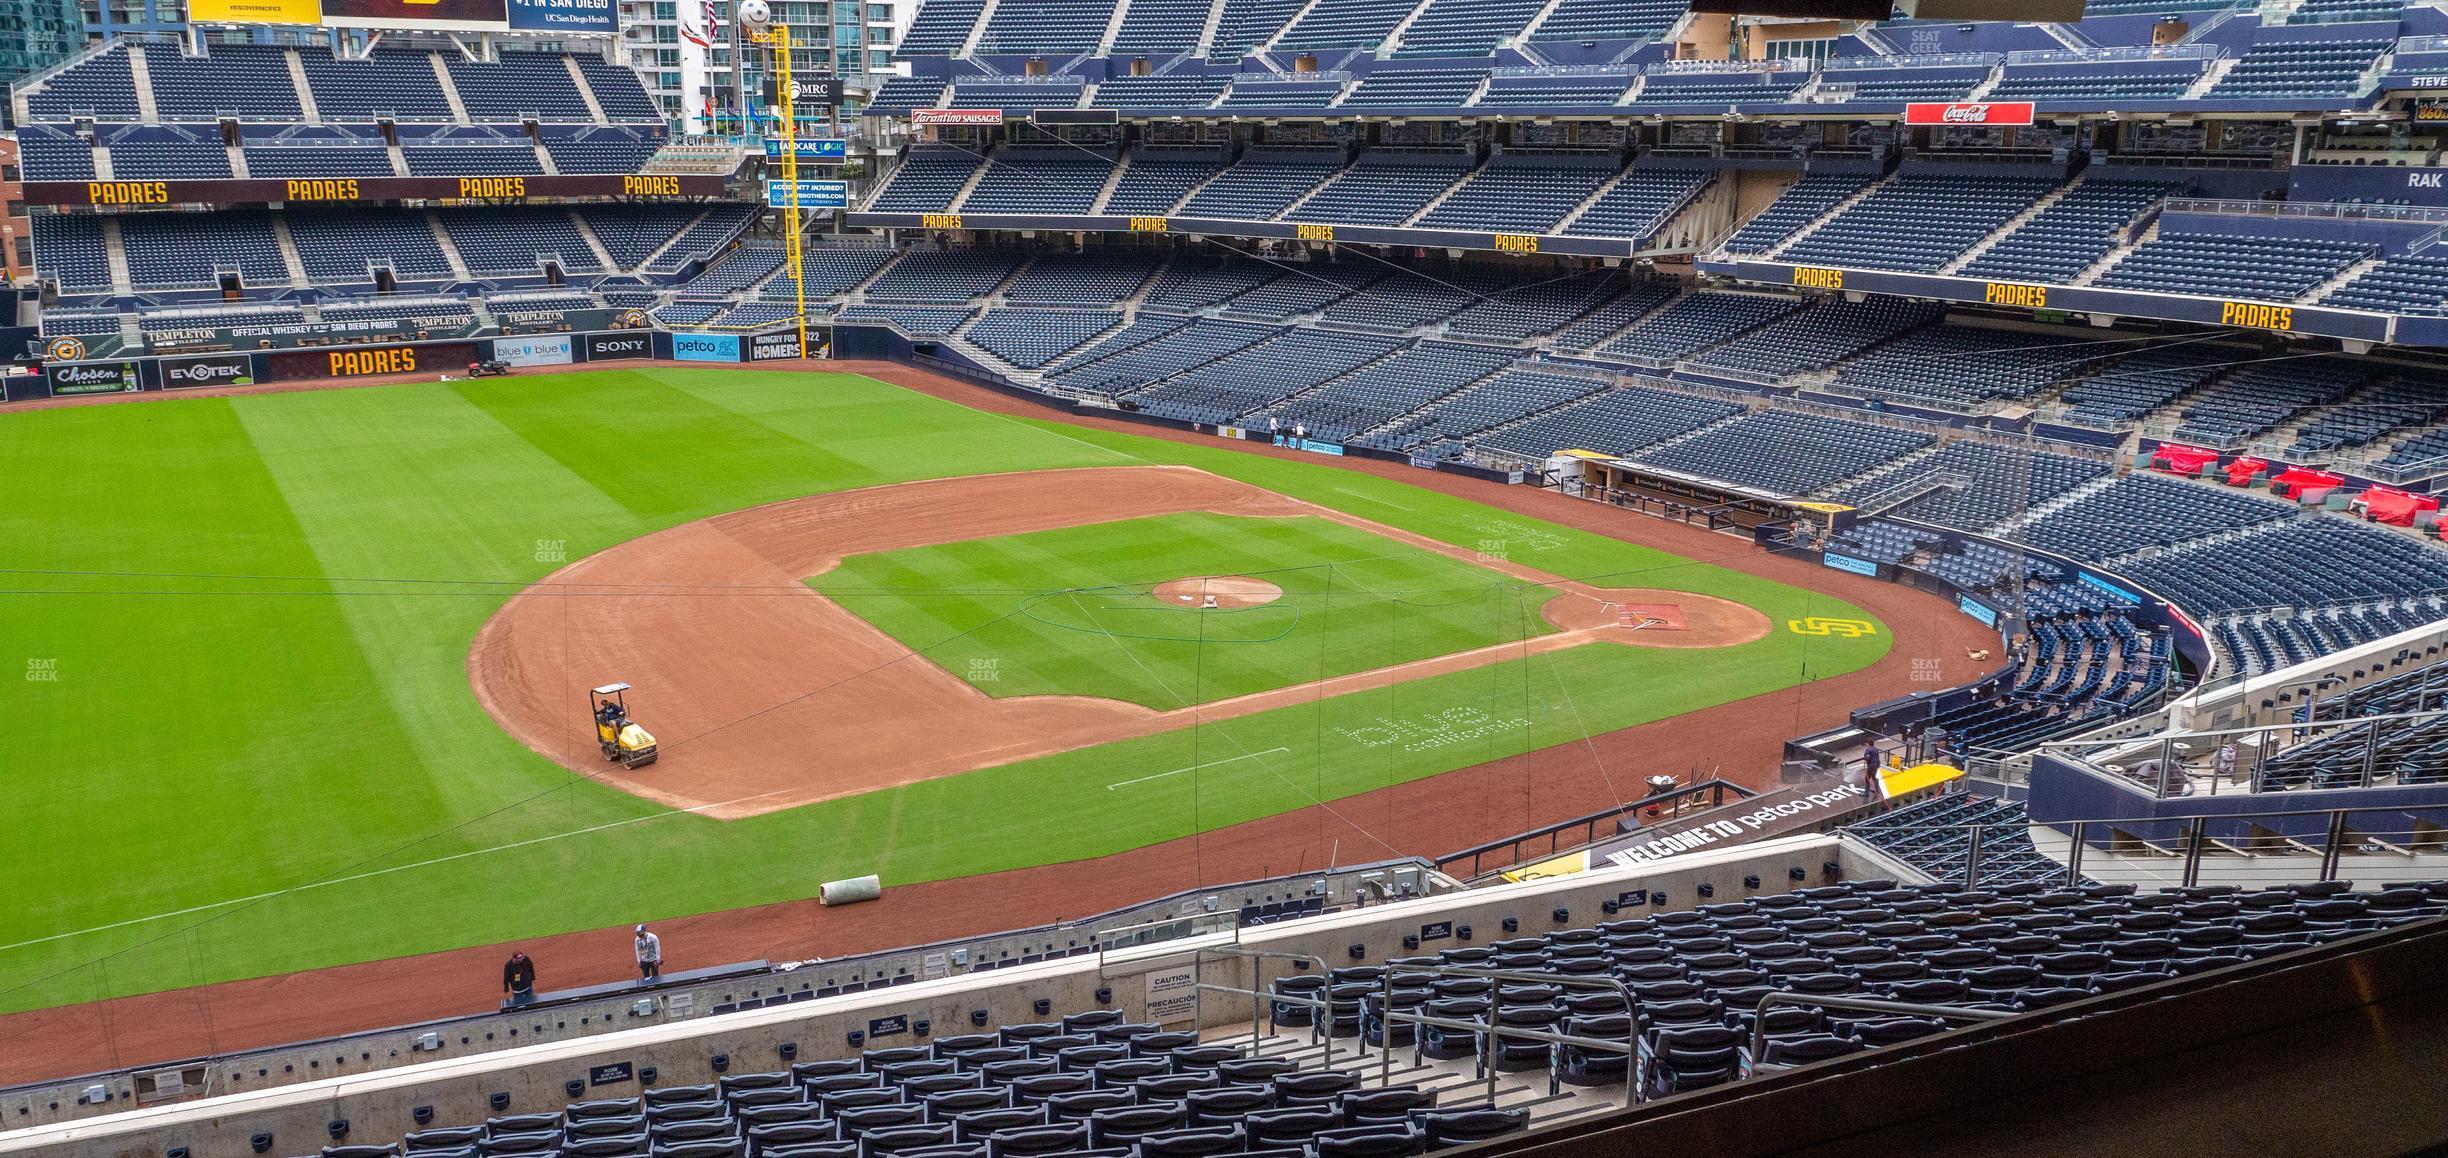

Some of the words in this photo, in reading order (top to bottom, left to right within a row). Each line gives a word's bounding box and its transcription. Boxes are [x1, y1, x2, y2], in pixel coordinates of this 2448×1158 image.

[550, 0, 572, 8] SAN
[576, 0, 608, 9] DIEGO
[571, 15, 588, 24] Diego
[589, 16, 610, 24] Health
[2411, 76, 2448, 87] STEVE
[801, 84, 828, 94] MRC
[913, 111, 962, 123] Tarantino
[962, 114, 1000, 123] SAUSAGES
[624, 176, 679, 195] PADRES
[2408, 172, 2444, 188] RAK
[88, 182, 168, 204] PADRES
[287, 179, 359, 200] PADRES
[460, 178, 525, 197] PADRES
[923, 215, 961, 228] PADRES
[1130, 217, 1167, 231] PADRES
[1297, 224, 1333, 240] PADRES
[1495, 234, 1537, 252] PADRES
[1793, 267, 1843, 288] PADRES
[1985, 283, 2047, 307] PADRES
[411, 316, 471, 328] TEMPLETON
[507, 312, 564, 323] TEMPLETON
[2221, 302, 2293, 330] PADRES
[147, 329, 216, 342] TEMPLETON
[232, 328, 271, 337] OFFICIAL
[273, 325, 311, 334] WHISKEY
[331, 322, 346, 332] SAN
[348, 321, 369, 331] DIEGO
[370, 320, 398, 330] PADRES
[755, 335, 782, 344] HUNGRY
[783, 334, 797, 343] FOR
[805, 331, 820, 342] 322
[497, 347, 521, 356] blue
[535, 344, 558, 354] blue
[596, 341, 645, 353] SONY
[677, 340, 716, 354] petco
[753, 344, 801, 359] HOMERS
[329, 348, 416, 377] PADRES
[57, 367, 118, 382] Chosen
[170, 364, 243, 381] EVOTEK
[1825, 555, 1850, 567] petco
[1962, 598, 1979, 613] petco
[1333, 706, 1489, 749] blue
[1605, 826, 1716, 866] WELCOME
[1705, 819, 1744, 839] TO
[1736, 796, 1812, 830] petco
[1804, 782, 1867, 808] park
[1154, 973, 1190, 985] CAUTION
